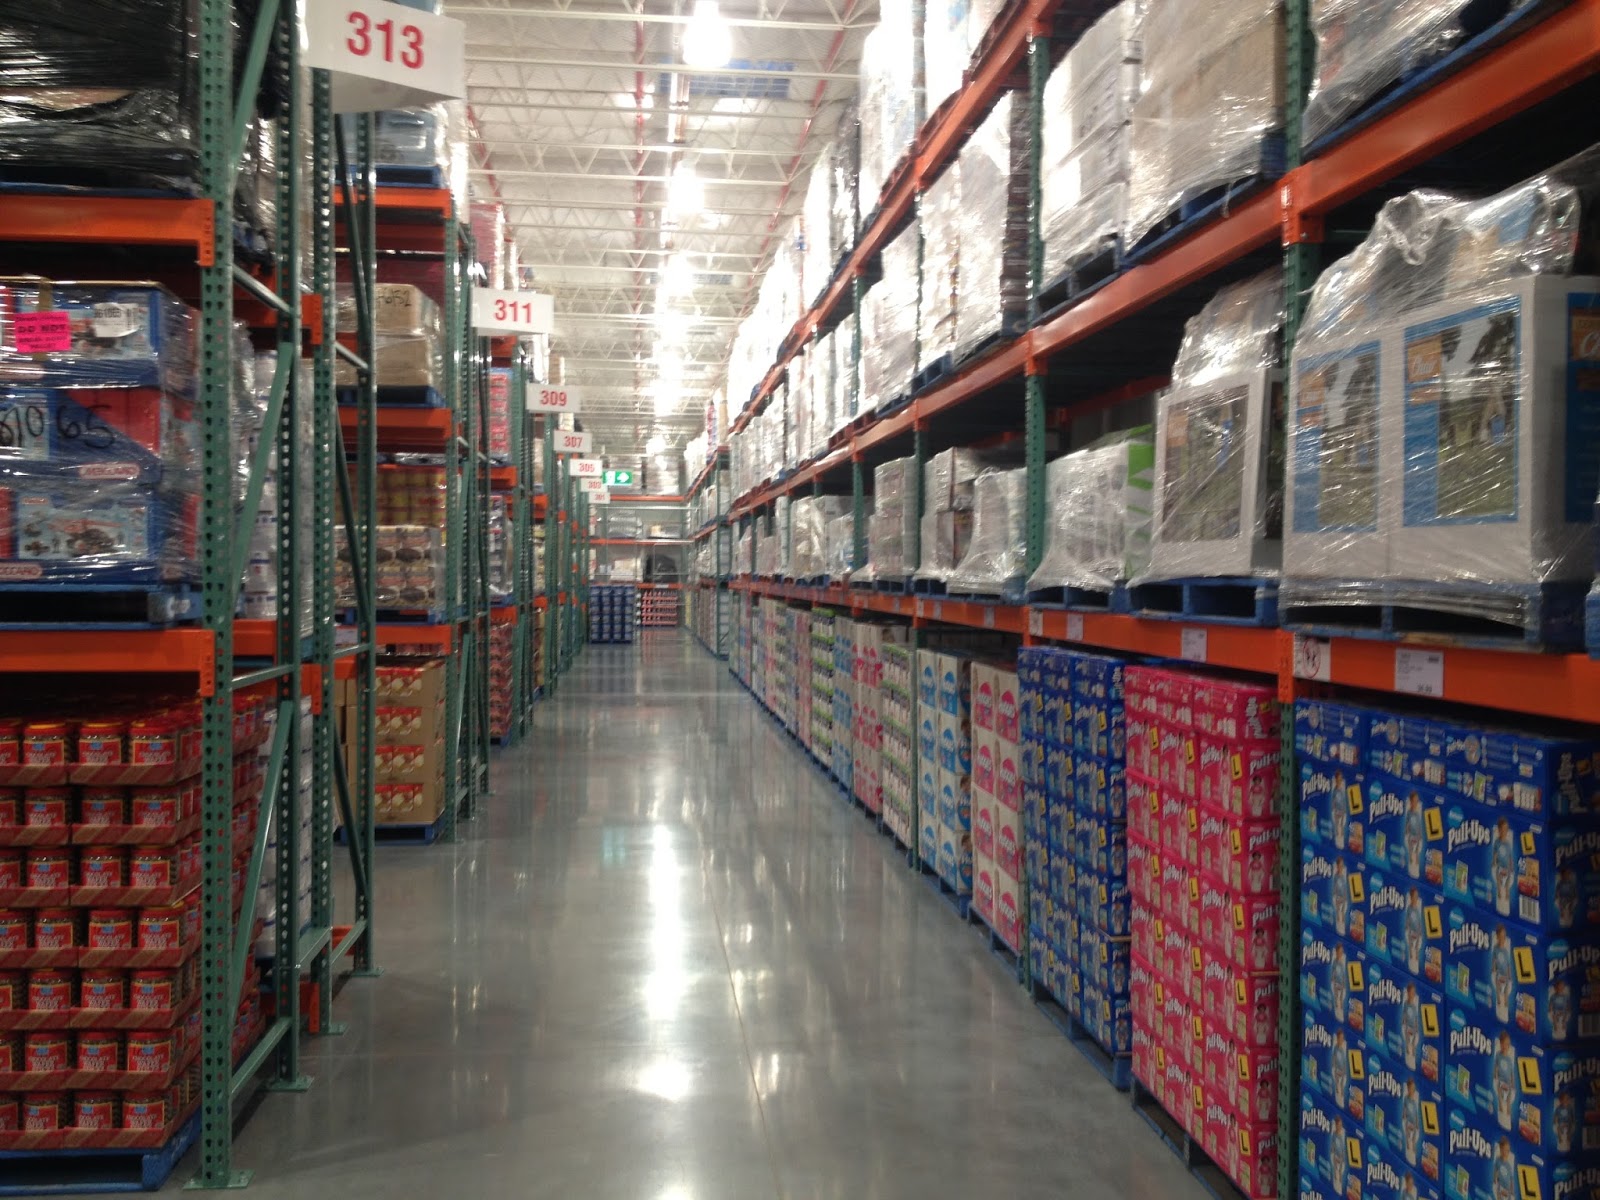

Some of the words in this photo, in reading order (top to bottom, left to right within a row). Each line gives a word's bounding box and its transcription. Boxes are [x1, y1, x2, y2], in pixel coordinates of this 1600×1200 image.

[346, 11, 425, 69] 313
[494, 299, 532, 324] 311
[540, 390, 567, 406] 309
[564, 436, 582, 447] 307
[1302, 772, 1331, 802] Pull-Ups
[1349, 789, 1359, 809] L
[1369, 793, 1404, 825] Pull-Ups
[1428, 813, 1439, 835] L
[1447, 819, 1491, 854] Pull-Ups
[1523, 836, 1532, 851] L
[1304, 856, 1332, 883] Pull-Ups
[1351, 877, 1361, 898] L
[1370, 886, 1405, 916] Pull-Ups
[1427, 910, 1438, 933] L
[1449, 922, 1490, 955] Pull-Ups
[1302, 941, 1331, 966] Pull-Ups
[1517, 951, 1531, 978] L
[1350, 965, 1360, 986] L
[1369, 979, 1402, 1006] Pull-Ups
[1424, 1007, 1435, 1032] L
[1305, 1024, 1332, 1048] Pull-Ups
[1450, 1025, 1492, 1056] Pull-Ups
[1351, 1053, 1361, 1075] L
[1522, 1061, 1536, 1089] L
[1368, 1071, 1402, 1099] Pull-Ups
[1302, 1108, 1331, 1133] Pull-Ups
[1424, 1105, 1436, 1130] L
[1349, 1141, 1359, 1164] L
[1450, 1127, 1492, 1159] Pull-Ups
[1367, 1162, 1400, 1191] Pull-Ups
[1522, 1168, 1536, 1198] L
